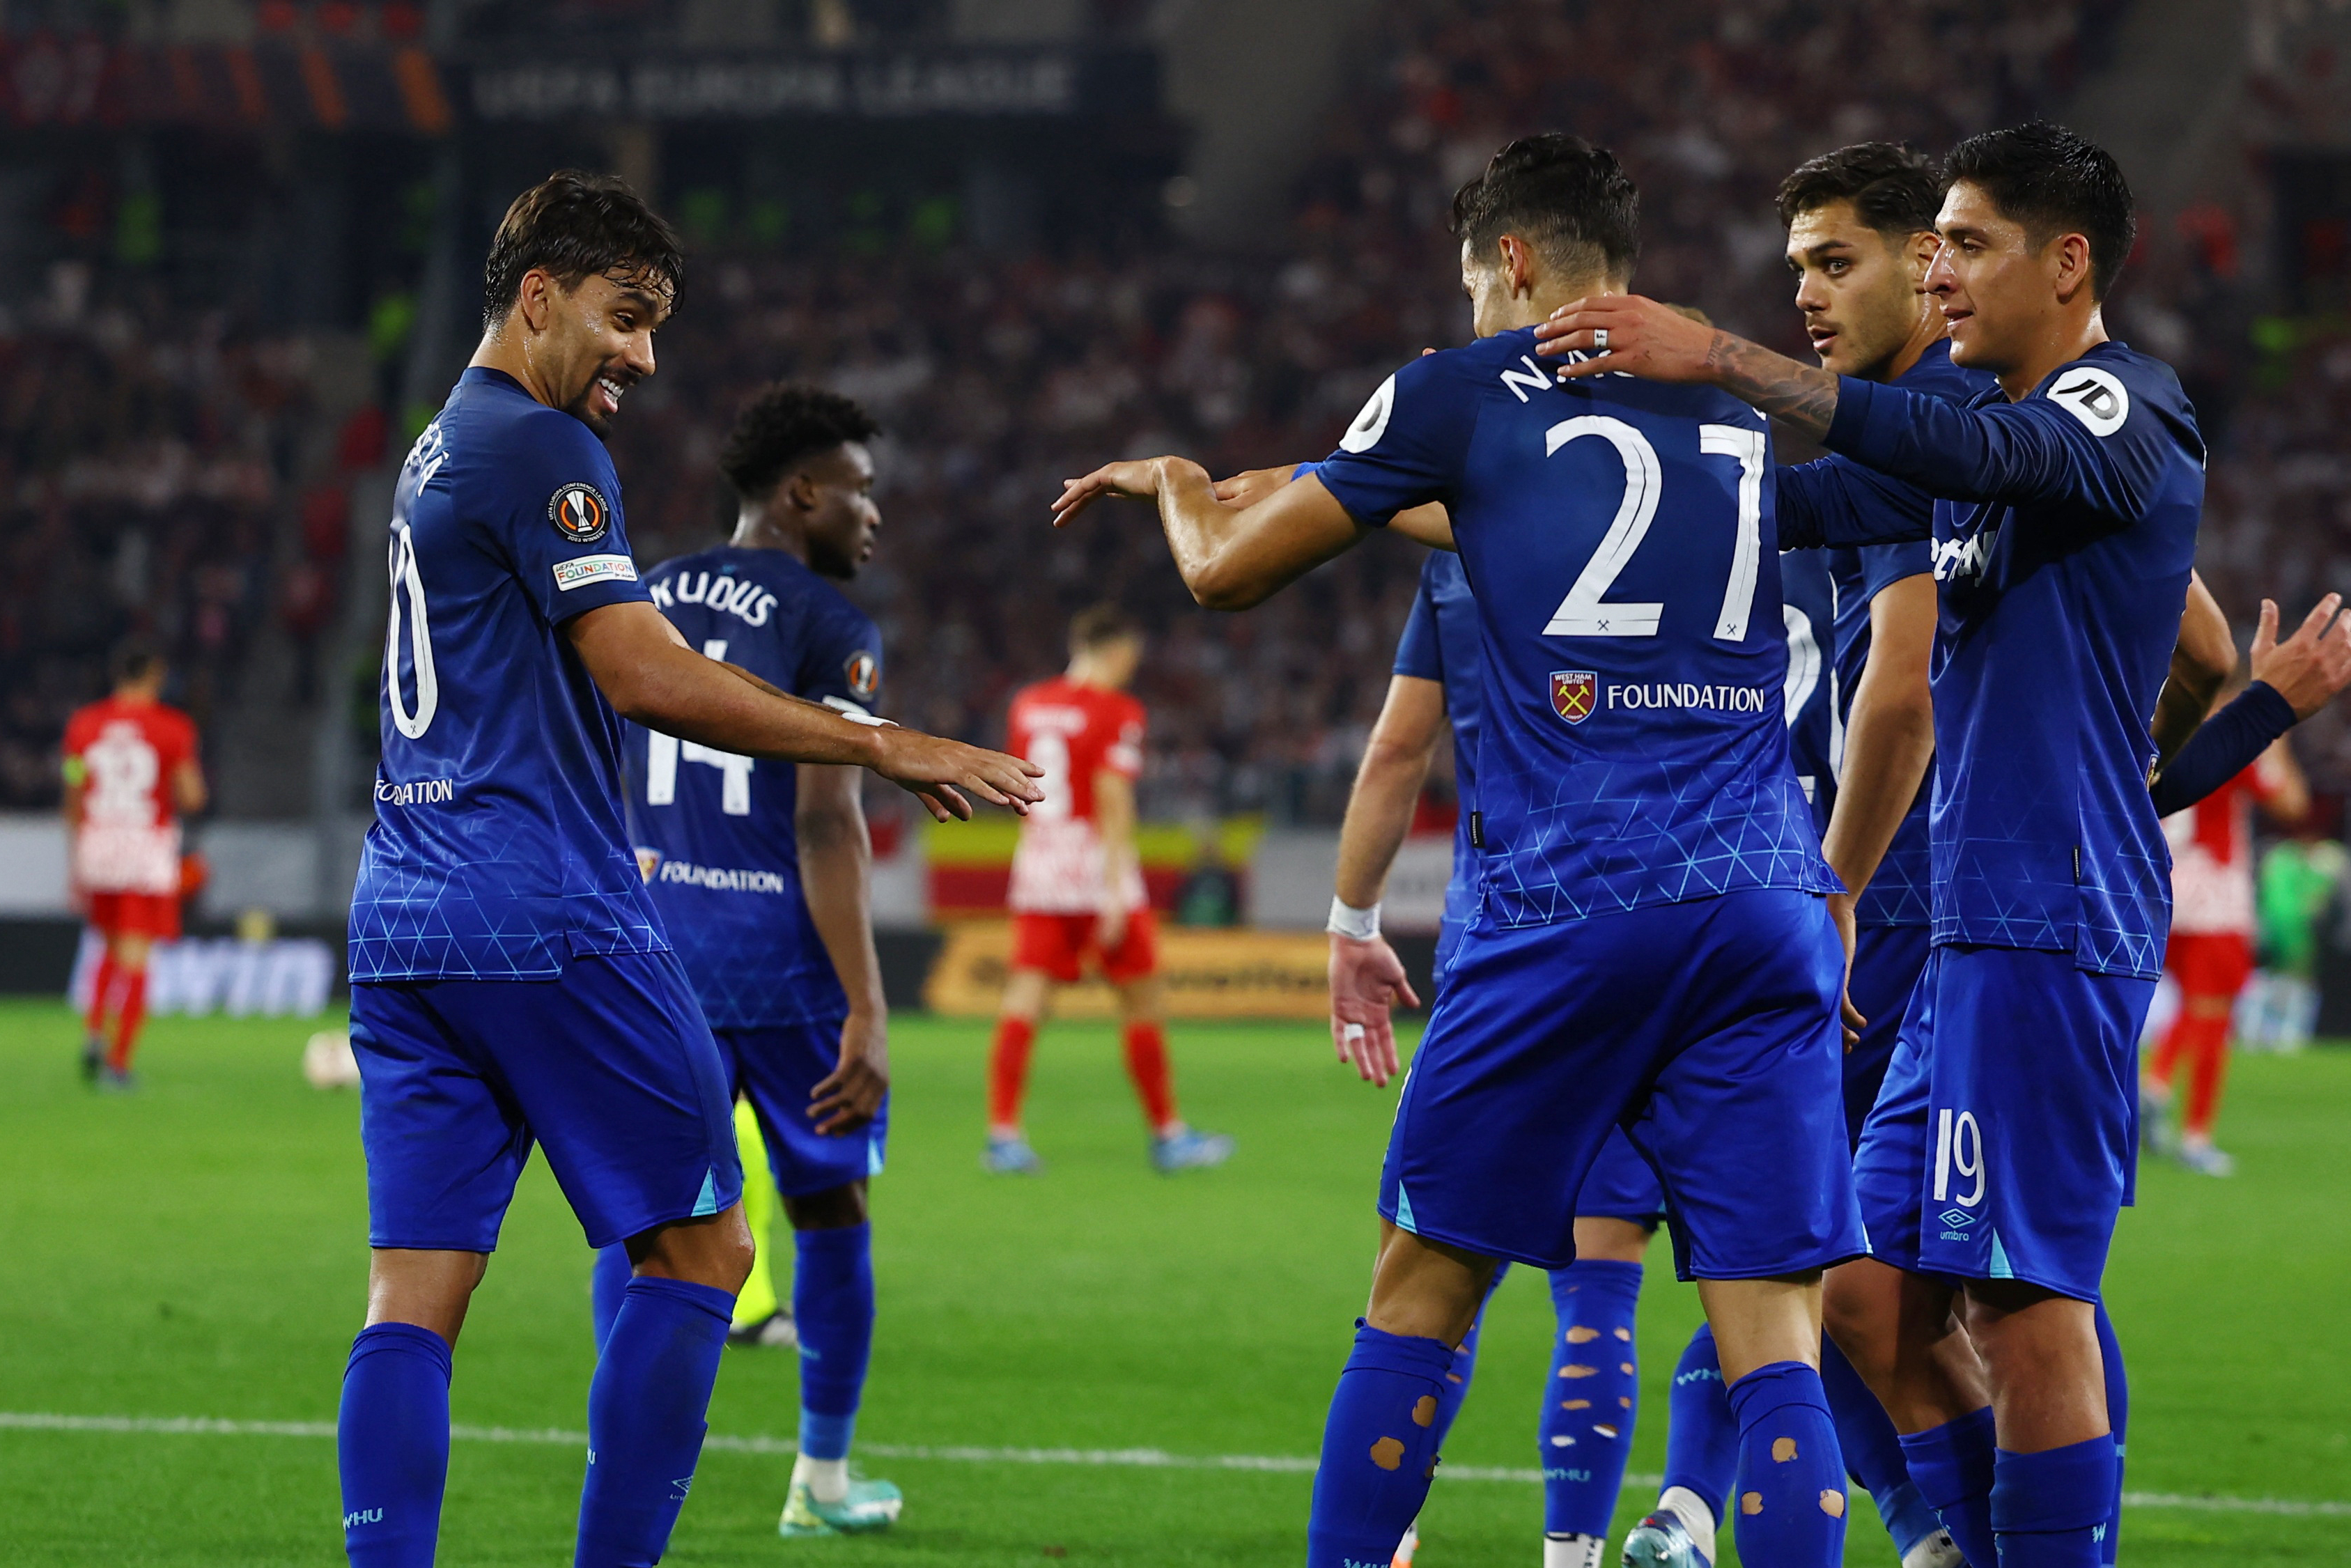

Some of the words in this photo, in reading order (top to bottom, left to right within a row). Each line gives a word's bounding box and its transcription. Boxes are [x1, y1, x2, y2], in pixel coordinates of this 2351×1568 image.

[549, 488, 563, 506] EUROPA
[562, 482, 596, 493] CONFERENCE
[595, 492, 609, 511] LEAGUE
[582, 530, 605, 543] WINNERS
[1542, 414, 1765, 642] 27
[556, 562, 575, 572] UEFA
[557, 562, 633, 581] FOUNDATION
[648, 571, 779, 626] KUDUS
[387, 525, 438, 739] 0
[1555, 673, 1574, 681] WEST
[1607, 683, 1764, 713] FOUNDATION
[660, 860, 784, 894] FOUNDATION
[1933, 1108, 1985, 1207] 19
[1940, 1231, 1969, 1241] umbro
[1677, 1367, 1721, 1385] WH
[342, 1507, 383, 1532] WHU
